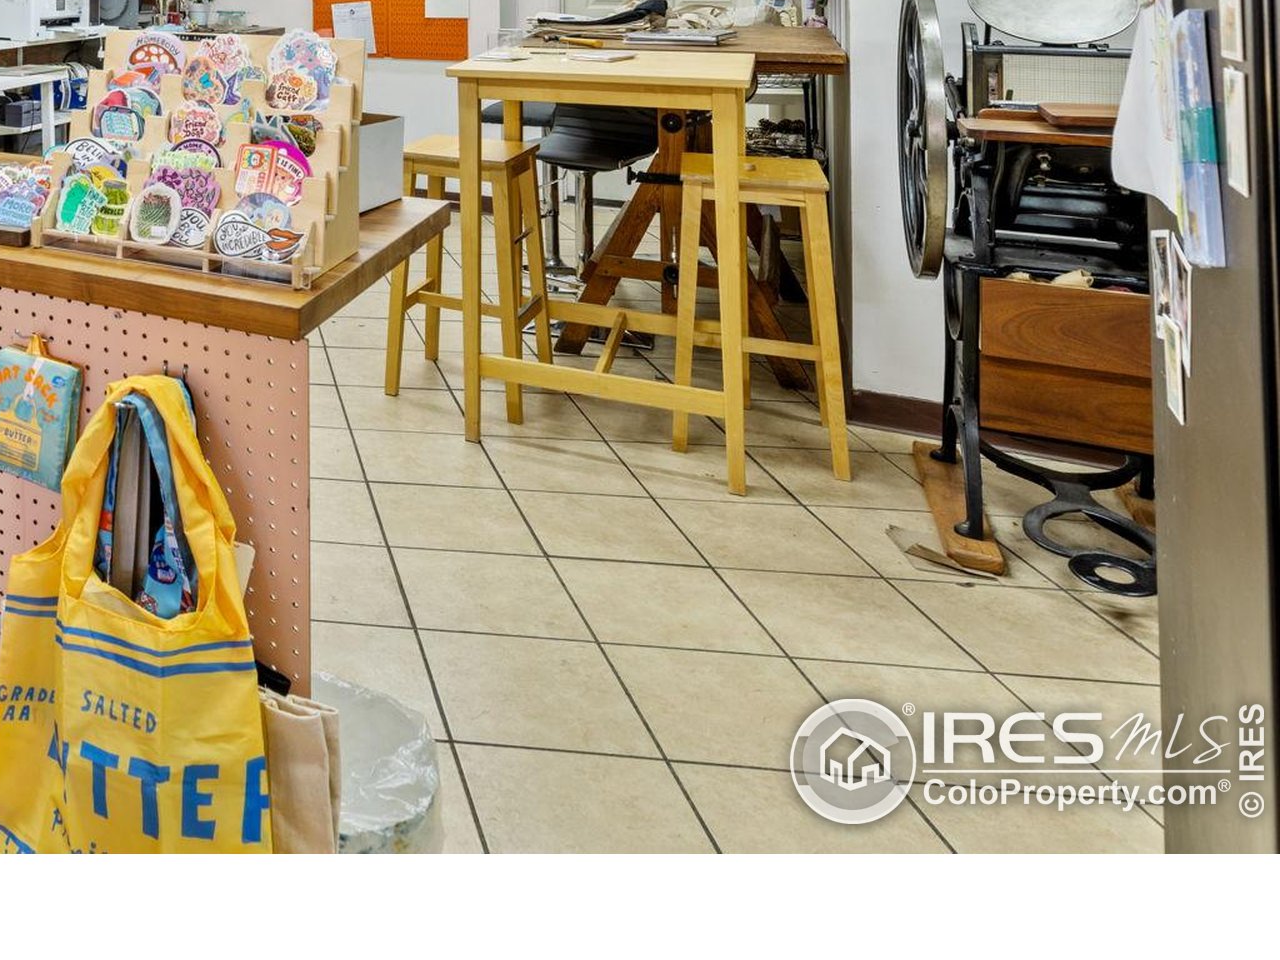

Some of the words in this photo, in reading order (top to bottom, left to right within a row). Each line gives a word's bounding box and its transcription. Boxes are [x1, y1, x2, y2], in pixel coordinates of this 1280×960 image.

[136, 37, 180, 56] HOMEBODY
[24, 367, 59, 409] SACK
[3, 426, 34, 444] BUTTER
[2, 704, 31, 721] AA
[81, 690, 157, 733] SALTED
